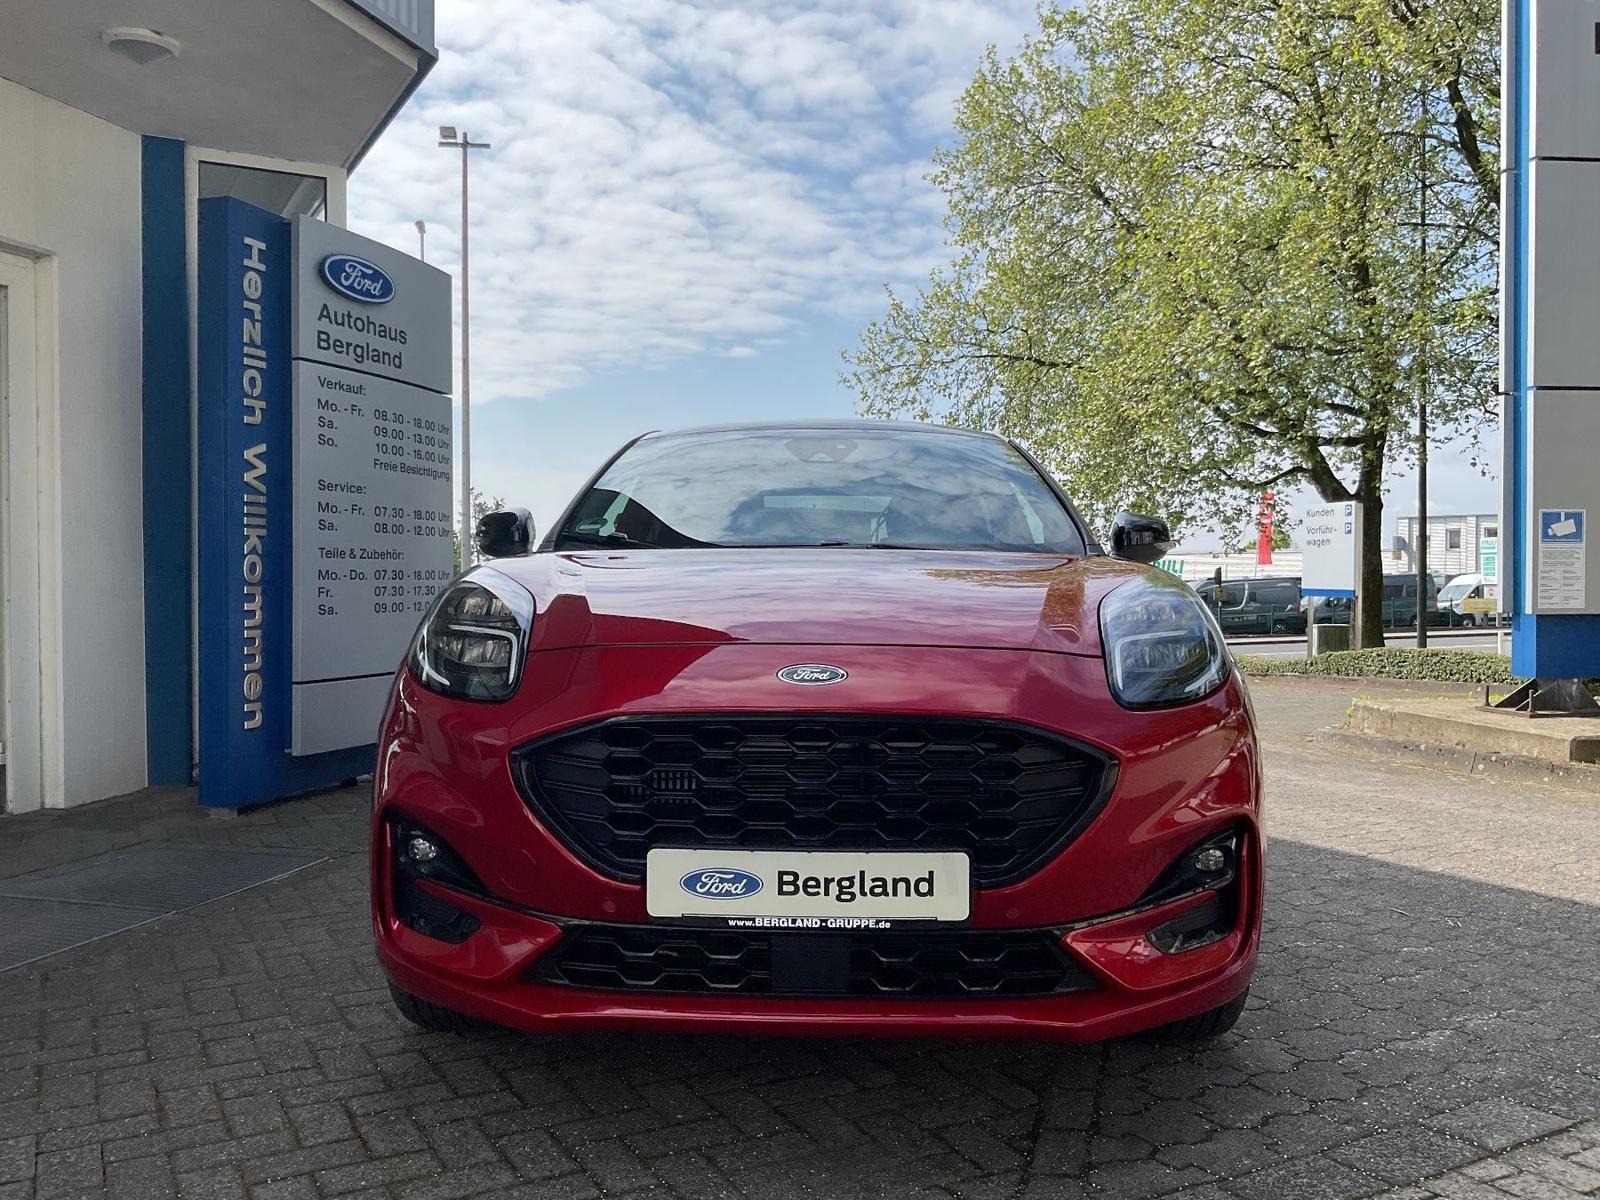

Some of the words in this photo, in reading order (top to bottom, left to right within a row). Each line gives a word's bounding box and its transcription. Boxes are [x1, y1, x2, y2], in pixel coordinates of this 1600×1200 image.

[243, 236, 267, 425] Herzlich
[317, 303, 408, 345] Autohaus
[316, 330, 402, 370] Bergland
[318, 376, 366, 396] Verkauf:
[317, 398, 341, 412] Mo.
[350, 404, 364, 417] Fr.
[374, 409, 404, 424] 08.30
[413, 416, 436, 432] 18.00
[438, 422, 450, 435] Uhr
[318, 416, 338, 430] Sa.
[374, 426, 404, 441] 09.00
[413, 434, 436, 447] 13.00
[438, 438, 450, 450] Uhr
[318, 433, 338, 448] So.
[375, 442, 404, 457] 10.00
[413, 449, 436, 462] 16.00
[438, 453, 450, 466] Uhr
[374, 458, 398, 472] Freie
[400, 462, 450, 482] Besichtigung
[318, 479, 367, 494] Service:
[318, 502, 341, 514] Mo.
[352, 504, 365, 516] Fr.
[374, 506, 404, 518] 07.30
[413, 510, 436, 521] 18.00
[438, 512, 450, 522] Uhr
[1306, 508, 1335, 518] Kunden
[318, 519, 338, 531] Sa.
[374, 522, 404, 535] 08.00
[413, 526, 436, 536] 12.00
[438, 527, 450, 538] Uhr
[1306, 525, 1337, 535] Vorführ-
[1306, 538, 1331, 548] wagen
[318, 547, 346, 560] Teile
[349, 548, 357, 560] &
[360, 548, 405, 560] Zubehör:
[318, 570, 341, 580] Mo.
[350, 570, 368, 580] Do.
[374, 570, 404, 580] 07.30
[413, 570, 436, 580] 18.00
[438, 570, 450, 580] Uhr
[243, 443, 267, 729] Willkommen
[318, 586, 333, 598] Fr.
[374, 586, 404, 597] 07.30
[413, 586, 436, 596] 17.30
[318, 604, 338, 616] Sa.
[374, 602, 404, 614] 09.00
[413, 602, 430, 612] 12.0
[696, 872, 746, 894] Ford
[777, 870, 935, 903] Bergland
[728, 917, 891, 930] www.BERGLAND-GRUPPE.de
